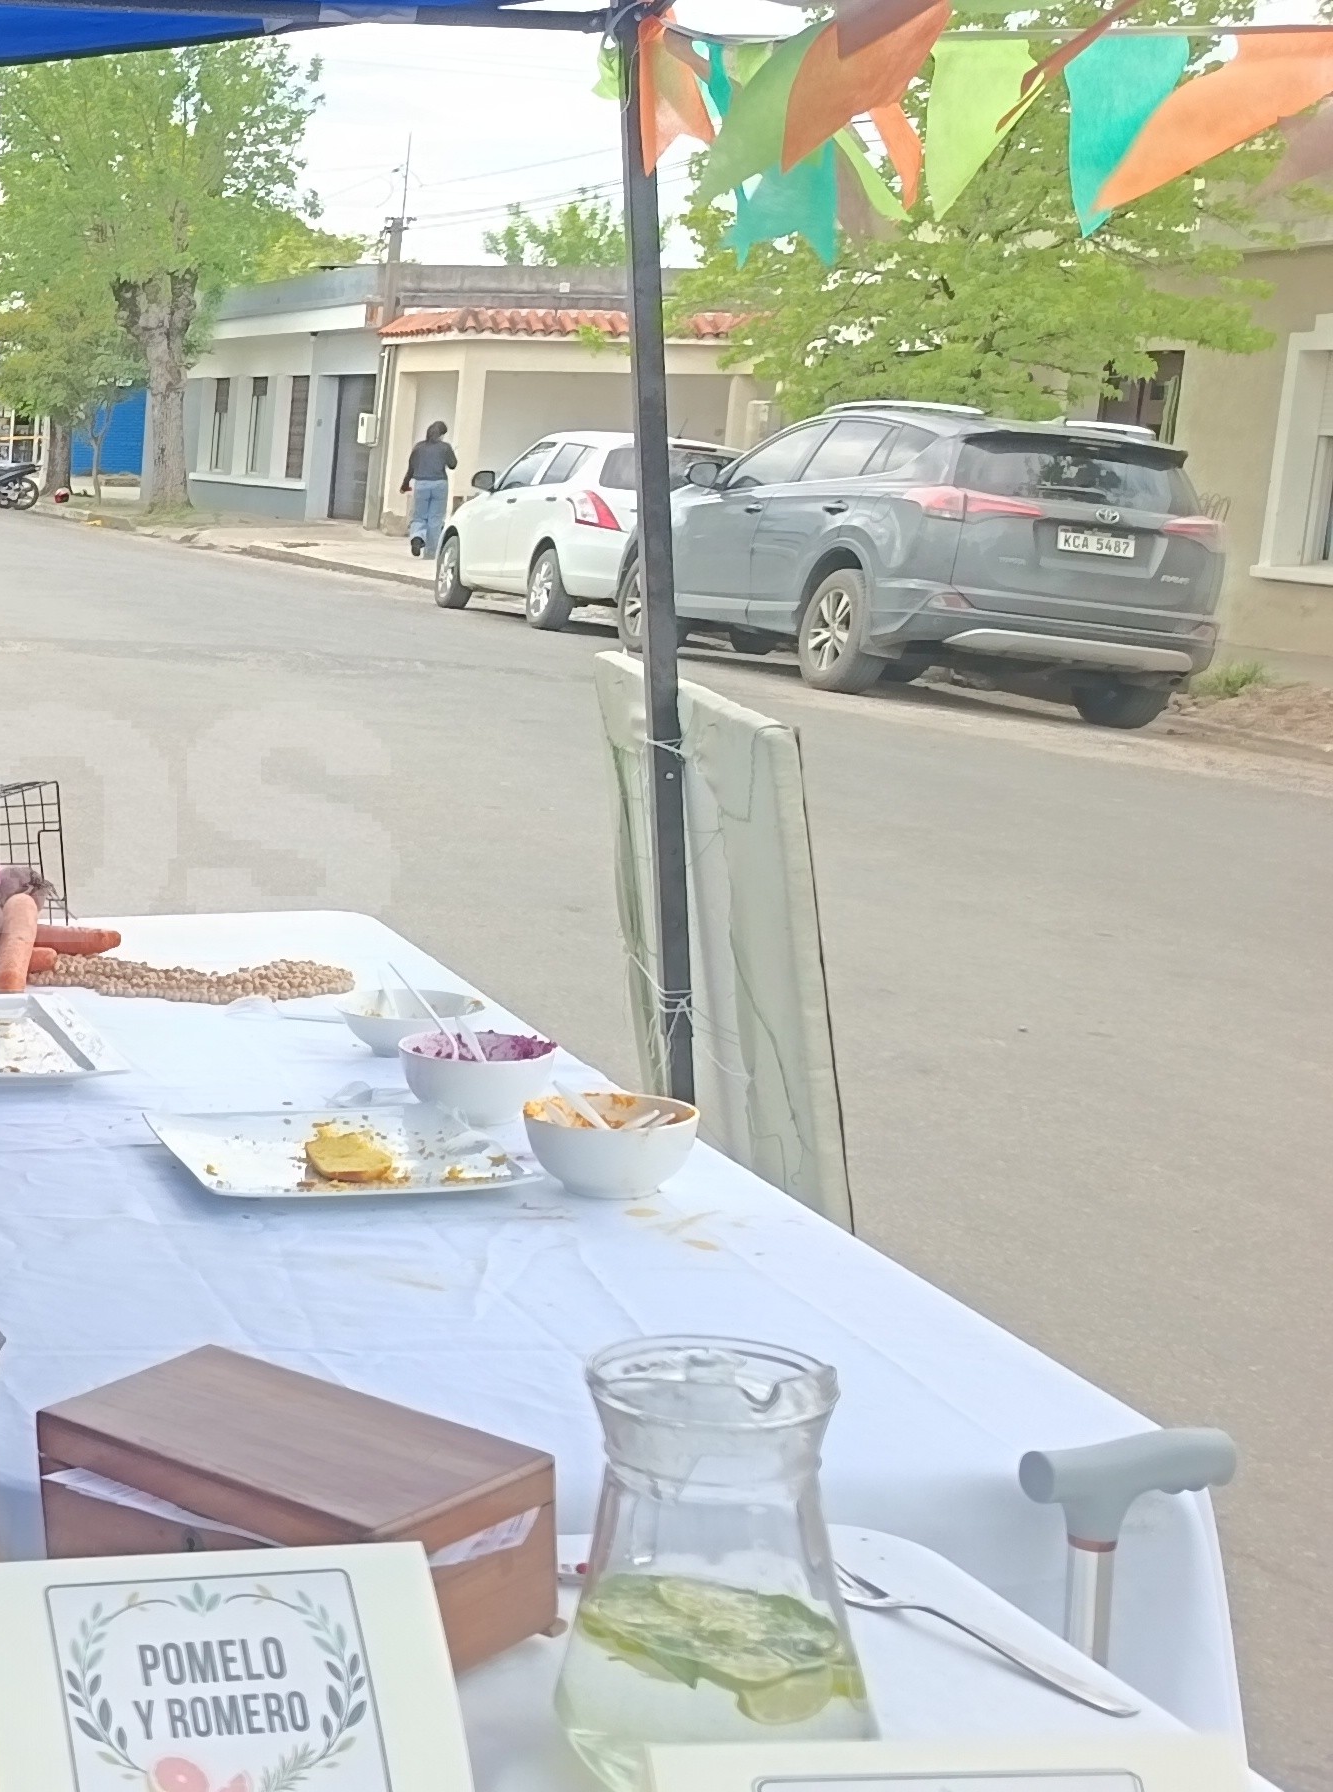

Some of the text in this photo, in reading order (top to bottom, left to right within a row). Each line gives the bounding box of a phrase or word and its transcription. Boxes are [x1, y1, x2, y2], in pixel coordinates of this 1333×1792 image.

[1063, 534, 1130, 554] KCA 5487
[137, 1635, 288, 1687] POMELO
[131, 1690, 311, 1741] Y ROMERO
